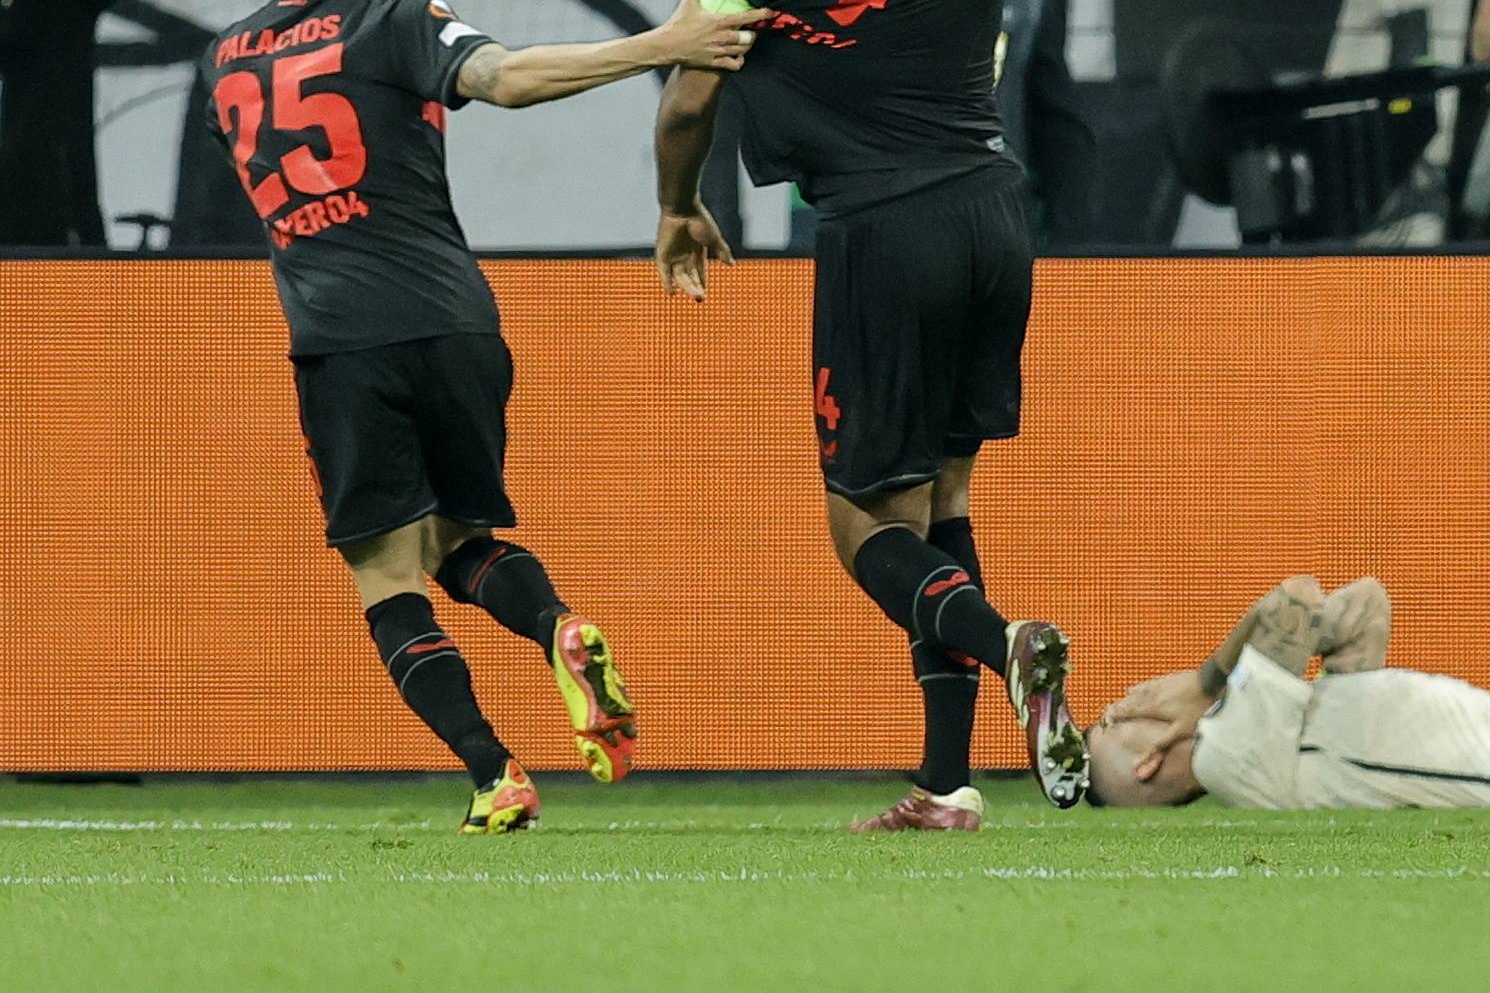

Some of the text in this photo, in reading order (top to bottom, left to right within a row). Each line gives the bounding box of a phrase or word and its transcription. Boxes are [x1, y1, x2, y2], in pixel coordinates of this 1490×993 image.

[215, 14, 341, 69] PALACIOS
[213, 42, 368, 219] 25
[816, 367, 840, 430] 4
